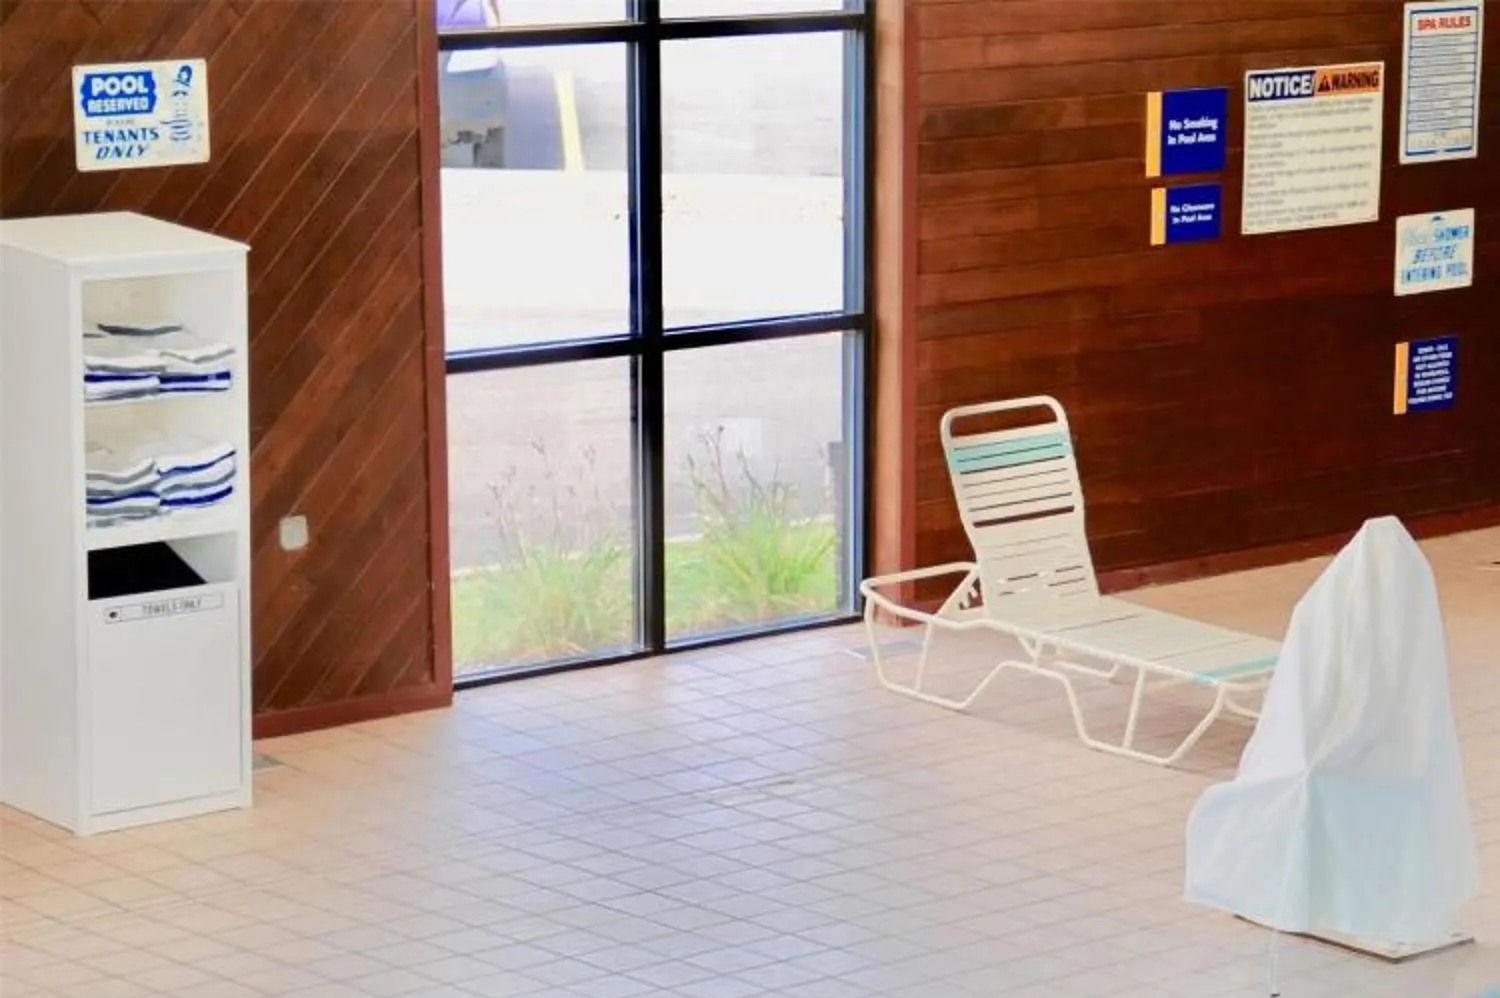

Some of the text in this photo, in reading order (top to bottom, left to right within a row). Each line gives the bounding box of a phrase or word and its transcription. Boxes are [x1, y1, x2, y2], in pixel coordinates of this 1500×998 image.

[1438, 16, 1471, 29] RULES
[91, 75, 149, 97] POOL
[1249, 70, 1379, 99] NOTICE WARNING
[87, 96, 149, 113] RESERVED
[1168, 116, 1218, 131] No Smoking
[83, 127, 160, 144] TENANTS
[1178, 132, 1196, 144] Pool
[1198, 131, 1217, 142] Area
[95, 143, 146, 160] ONLY
